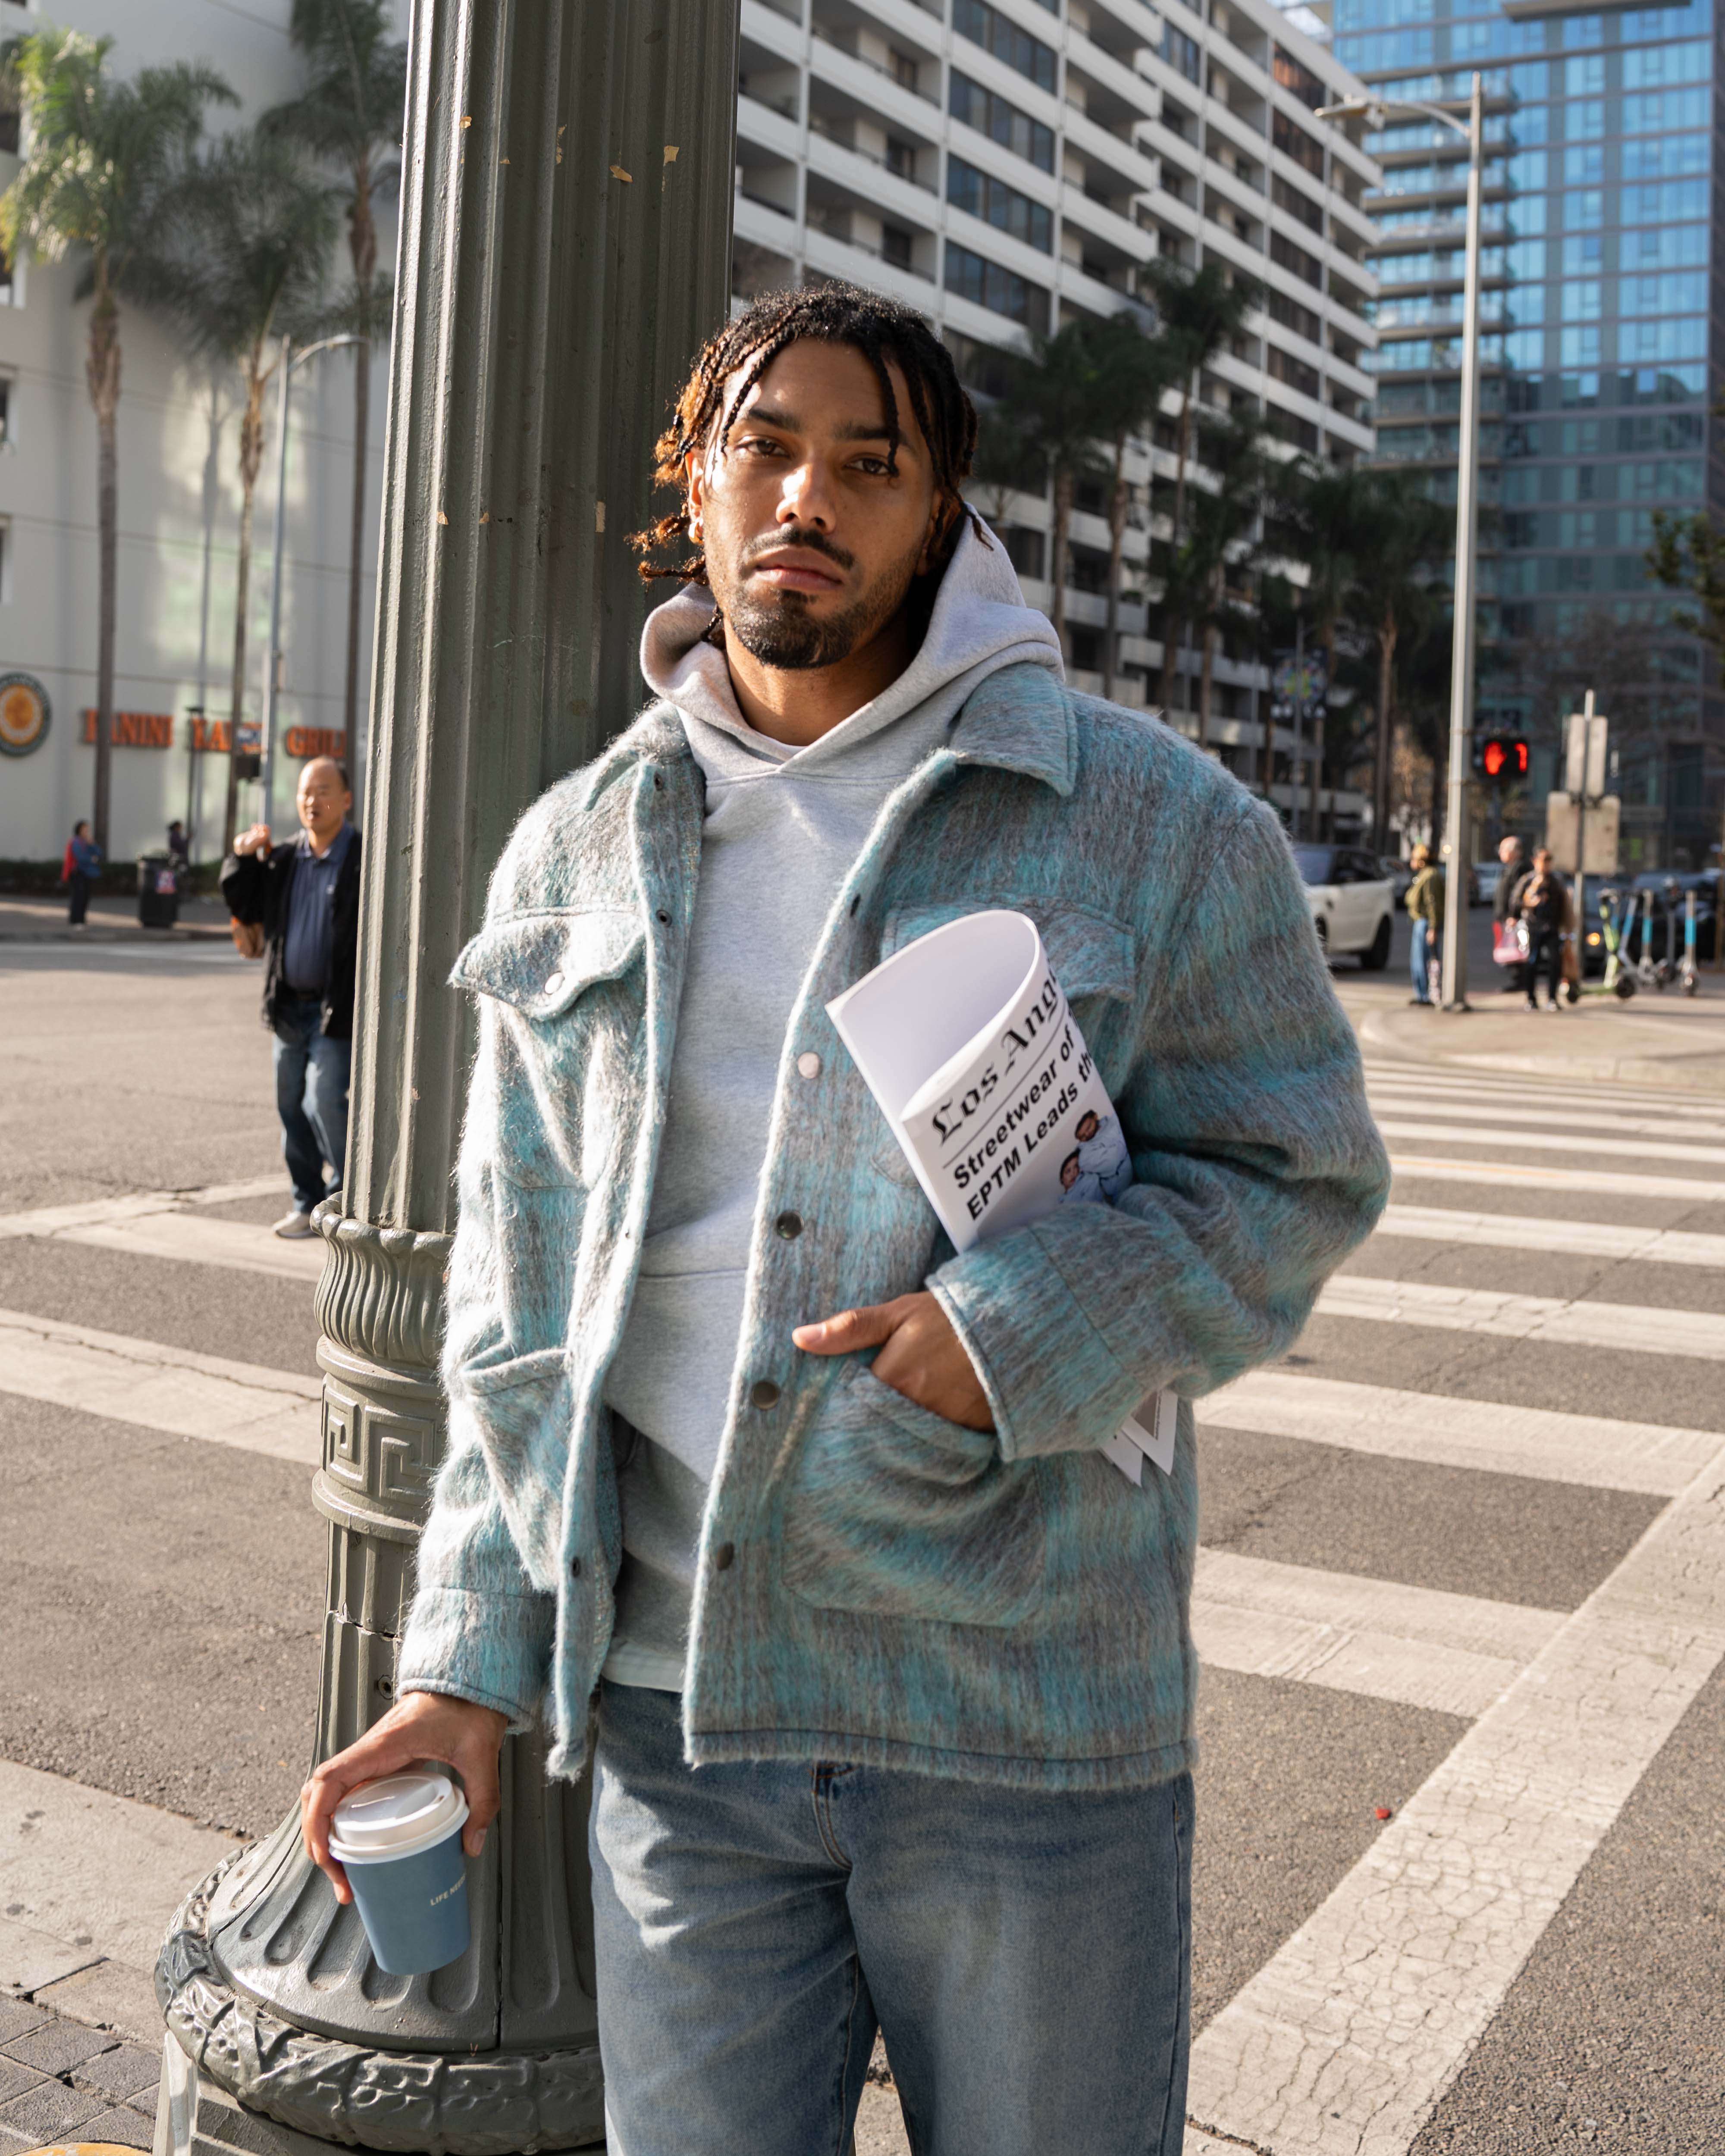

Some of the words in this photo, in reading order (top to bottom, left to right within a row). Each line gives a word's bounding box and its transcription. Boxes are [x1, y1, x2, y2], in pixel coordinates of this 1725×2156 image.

[932, 1062, 998, 1147] Los
[1000, 969, 1058, 1077] Ang
[954, 1059, 1057, 1189] Streetwear
[1060, 1024, 1074, 1062] of
[966, 1147, 1022, 1221] EPTM
[1024, 1082, 1078, 1154] Leads
[1079, 1051, 1092, 1083] th
[430, 1890, 448, 1906] LIFE
